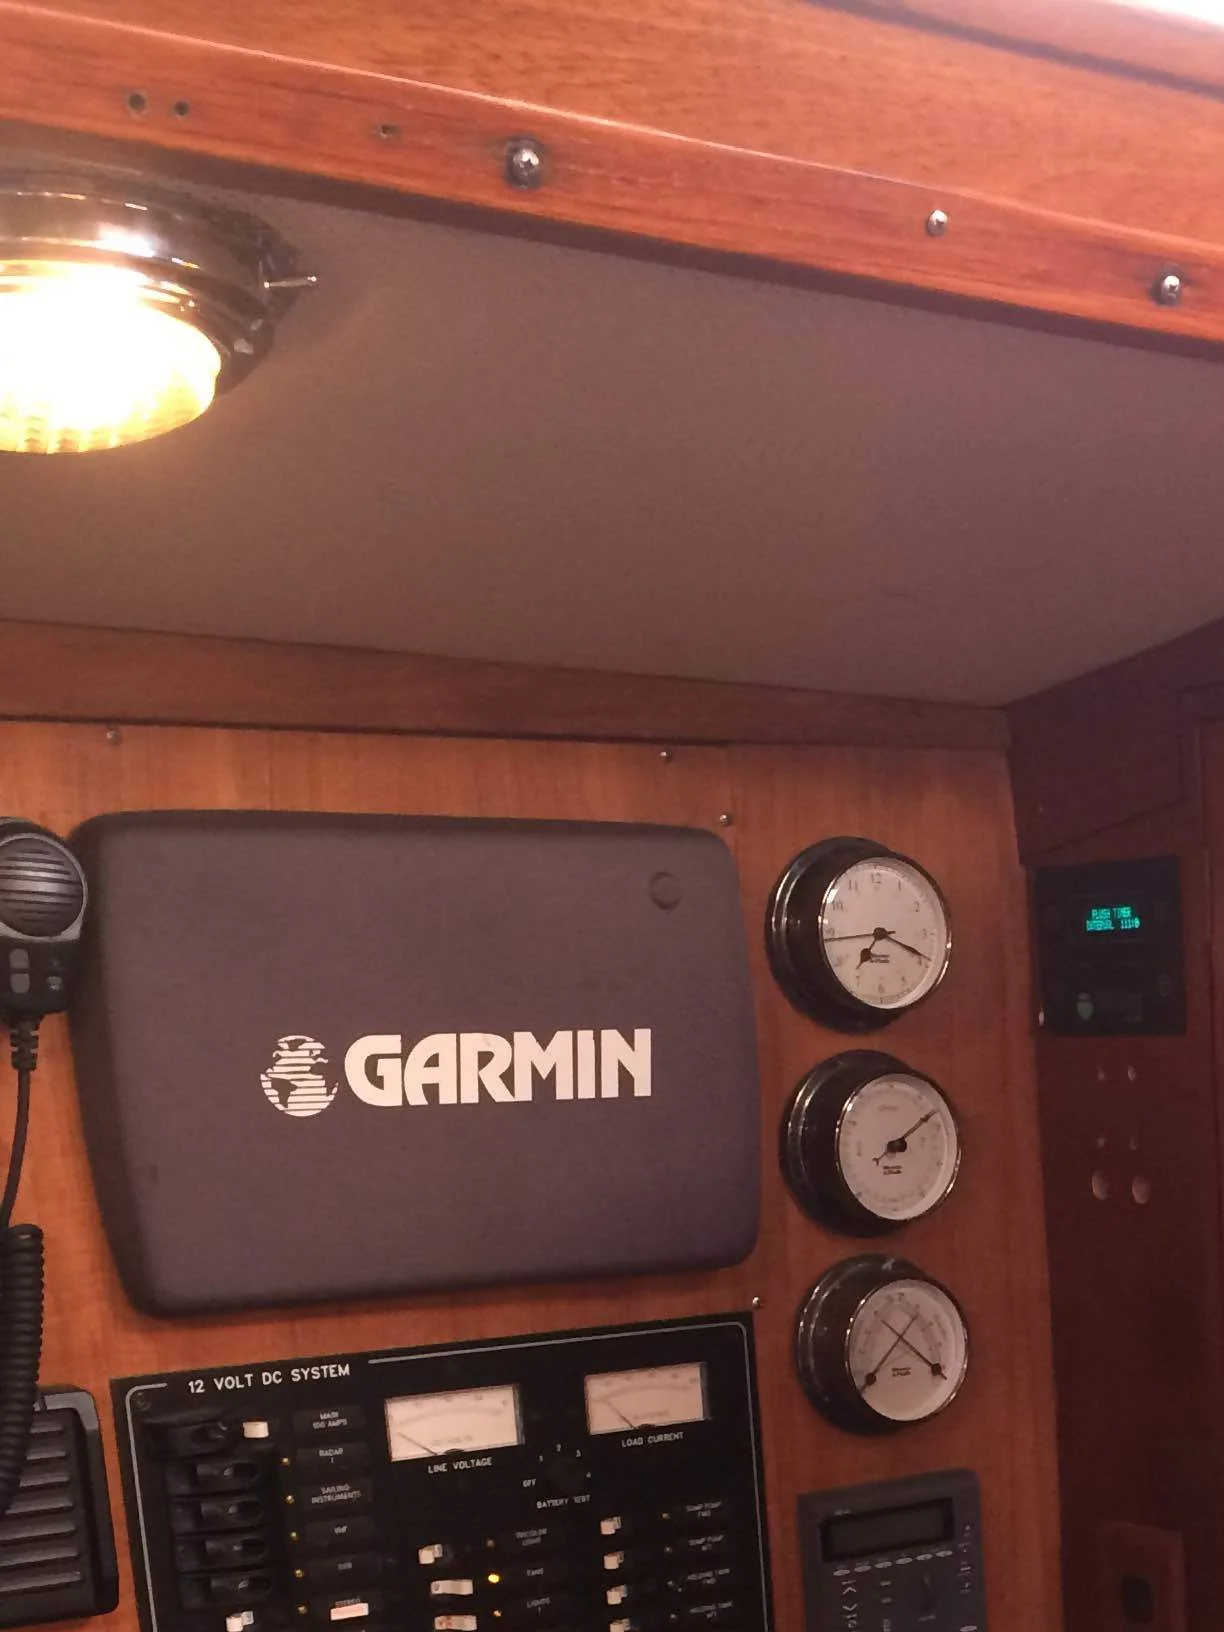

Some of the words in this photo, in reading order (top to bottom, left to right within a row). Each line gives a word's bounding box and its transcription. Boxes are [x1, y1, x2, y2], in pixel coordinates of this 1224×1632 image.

[869, 872, 883, 885] 12
[345, 1028, 652, 1107] GARMIN
[188, 1379, 206, 1394] 12
[214, 1373, 254, 1391] VOLT
[261, 1371, 283, 1386] DC
[290, 1363, 351, 1382] SYSTEM
[621, 1436, 644, 1448] LOAD
[647, 1431, 684, 1444] CURRENT
[428, 1463, 448, 1474] LINE
[453, 1457, 493, 1470] VOLTAGE
